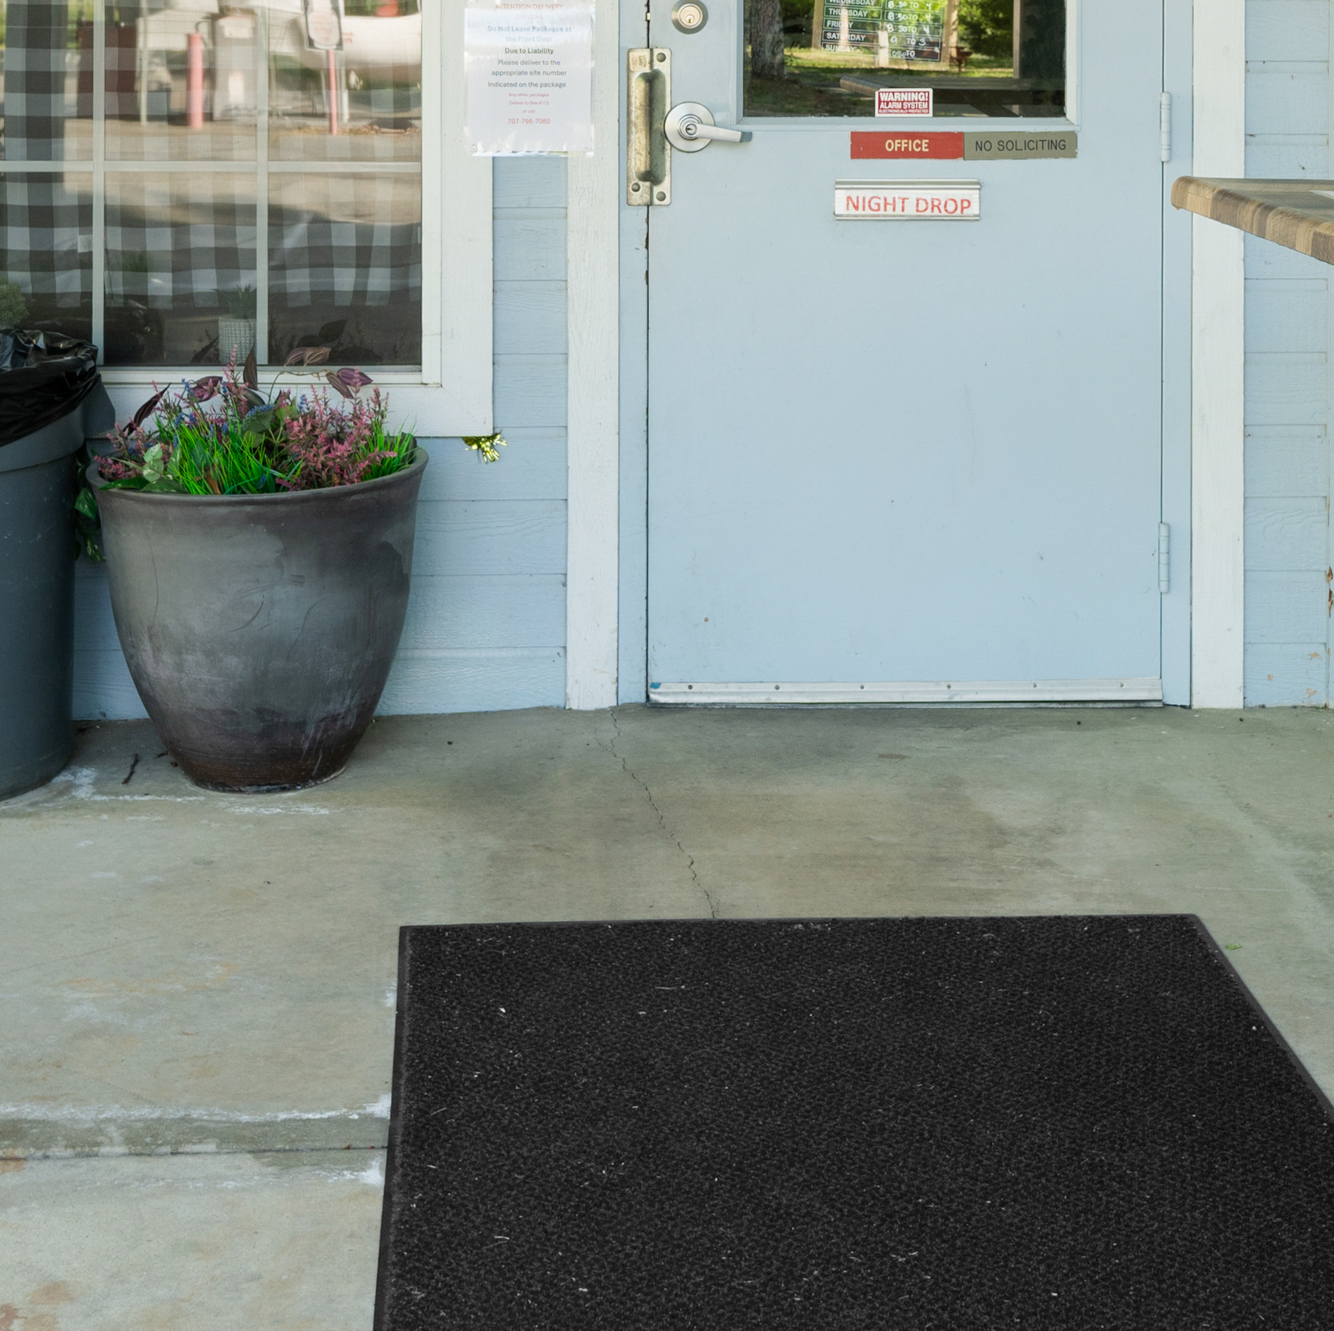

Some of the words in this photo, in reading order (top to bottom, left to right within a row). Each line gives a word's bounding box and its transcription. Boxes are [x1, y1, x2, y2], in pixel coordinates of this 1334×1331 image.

[829, 9, 867, 17] THURSDAY
[827, 33, 865, 41] SATURDAY
[880, 92, 928, 101] WARNING!
[885, 139, 929, 152] OFFICE
[976, 140, 992, 151] NO
[997, 140, 1066, 151] SOLICITING
[846, 196, 909, 212] NIGHT
[916, 198, 971, 214] DROP
